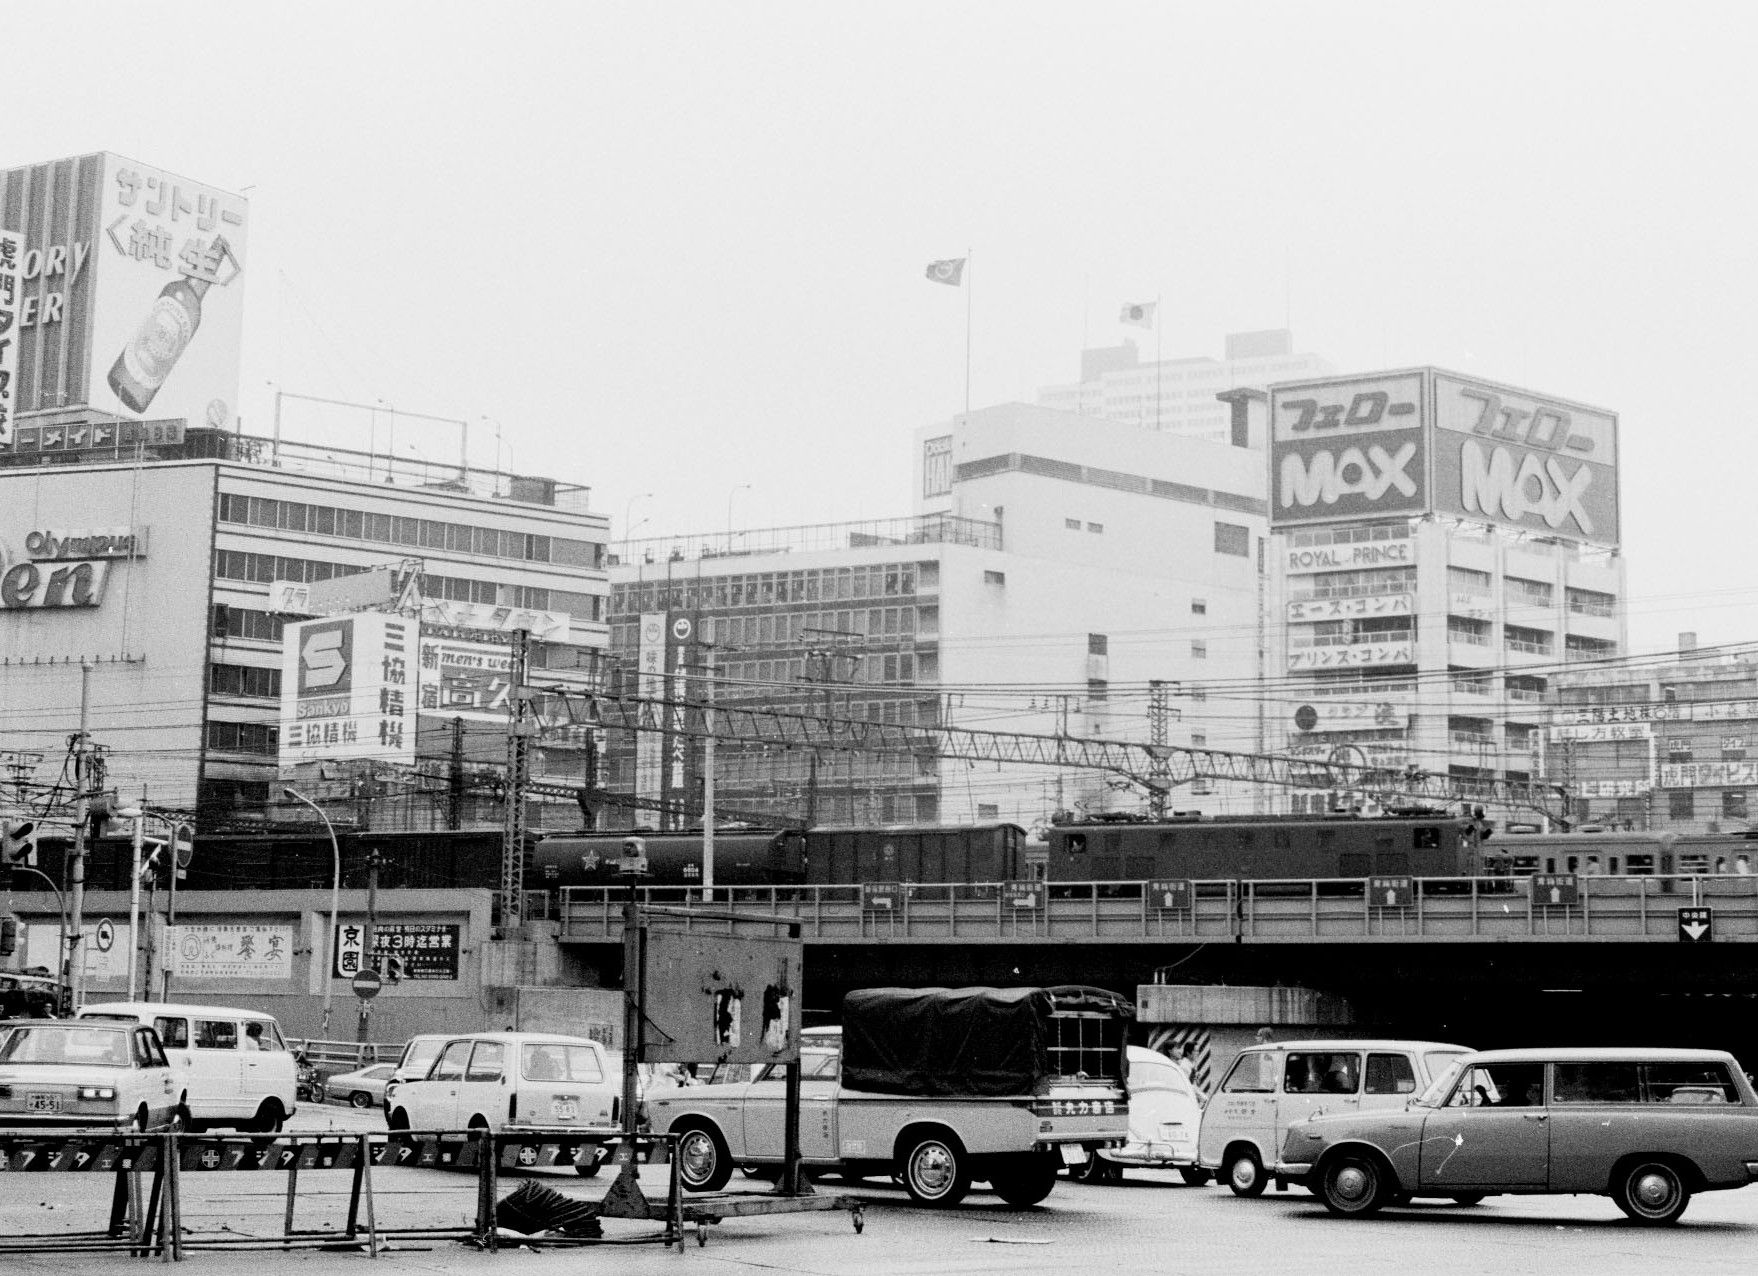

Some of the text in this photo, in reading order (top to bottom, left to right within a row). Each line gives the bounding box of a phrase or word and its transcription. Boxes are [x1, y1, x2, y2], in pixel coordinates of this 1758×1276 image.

[116, 167, 243, 231] サントリー
[1282, 391, 1415, 431] フェロー
[1460, 387, 1595, 452] フェロー
[1281, 441, 1417, 508] MAX
[1461, 438, 1593, 536] MAX
[1289, 544, 1407, 569] ROYAL PRINCE
[0, 562, 94, 608] en
[379, 622, 406, 749] 三協精機
[421, 643, 440, 708] 新宿
[288, 719, 358, 749] 三協精機
[298, 699, 350, 718] Sankyo
[373, 1146, 452, 1163] ジタ工業
